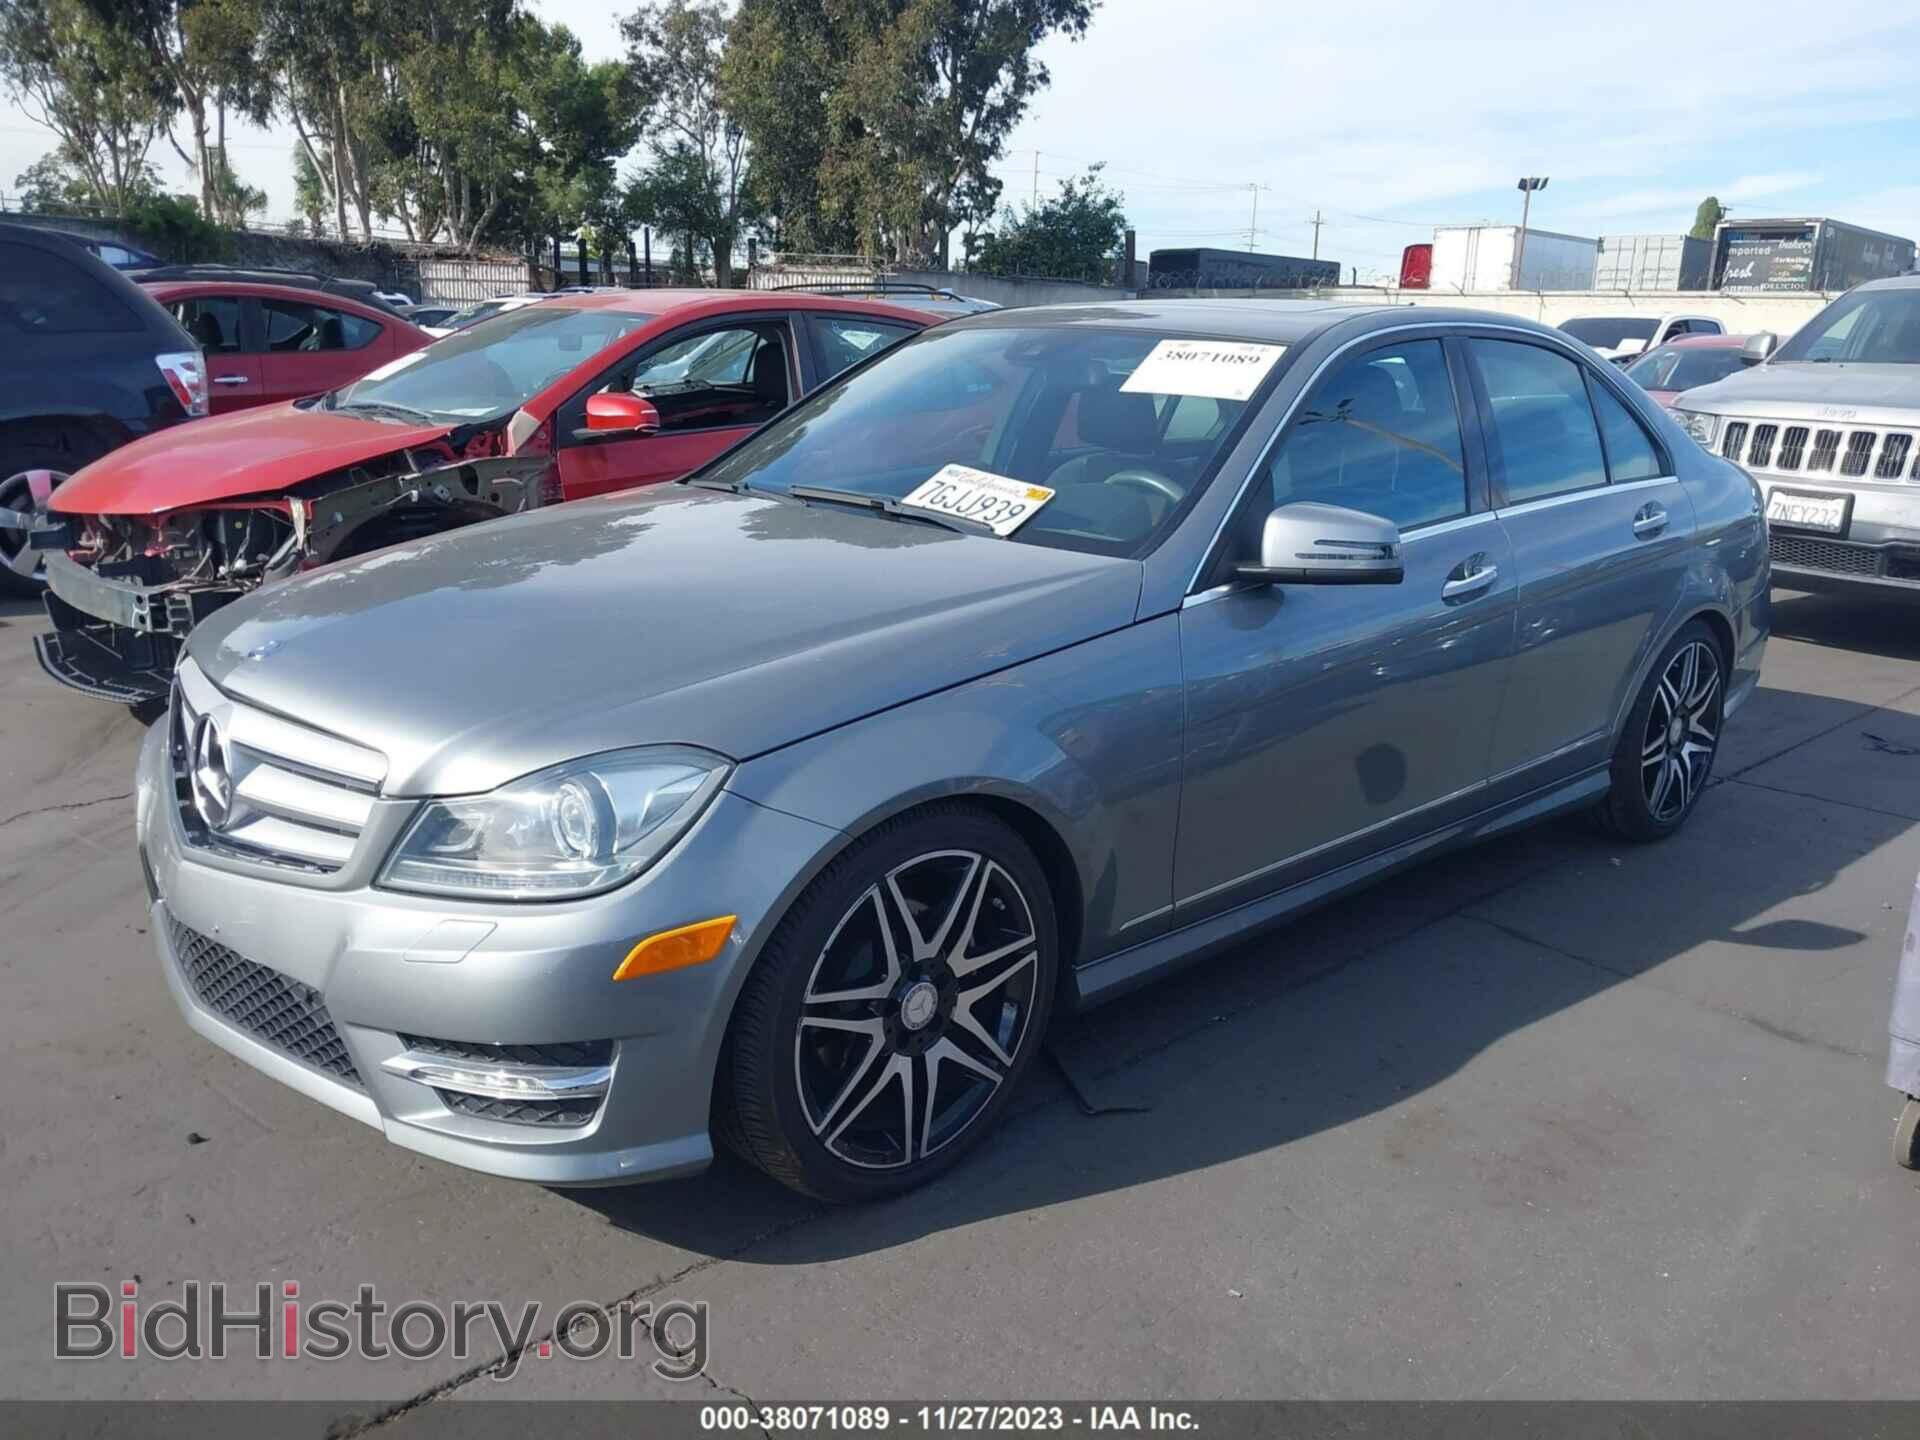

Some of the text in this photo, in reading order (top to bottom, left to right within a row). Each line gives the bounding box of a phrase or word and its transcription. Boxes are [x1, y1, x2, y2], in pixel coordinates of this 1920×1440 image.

[1728, 246, 1771, 256] mported
[1158, 350, 1261, 365] 38071089
[918, 480, 1026, 524] 7GJJ939
